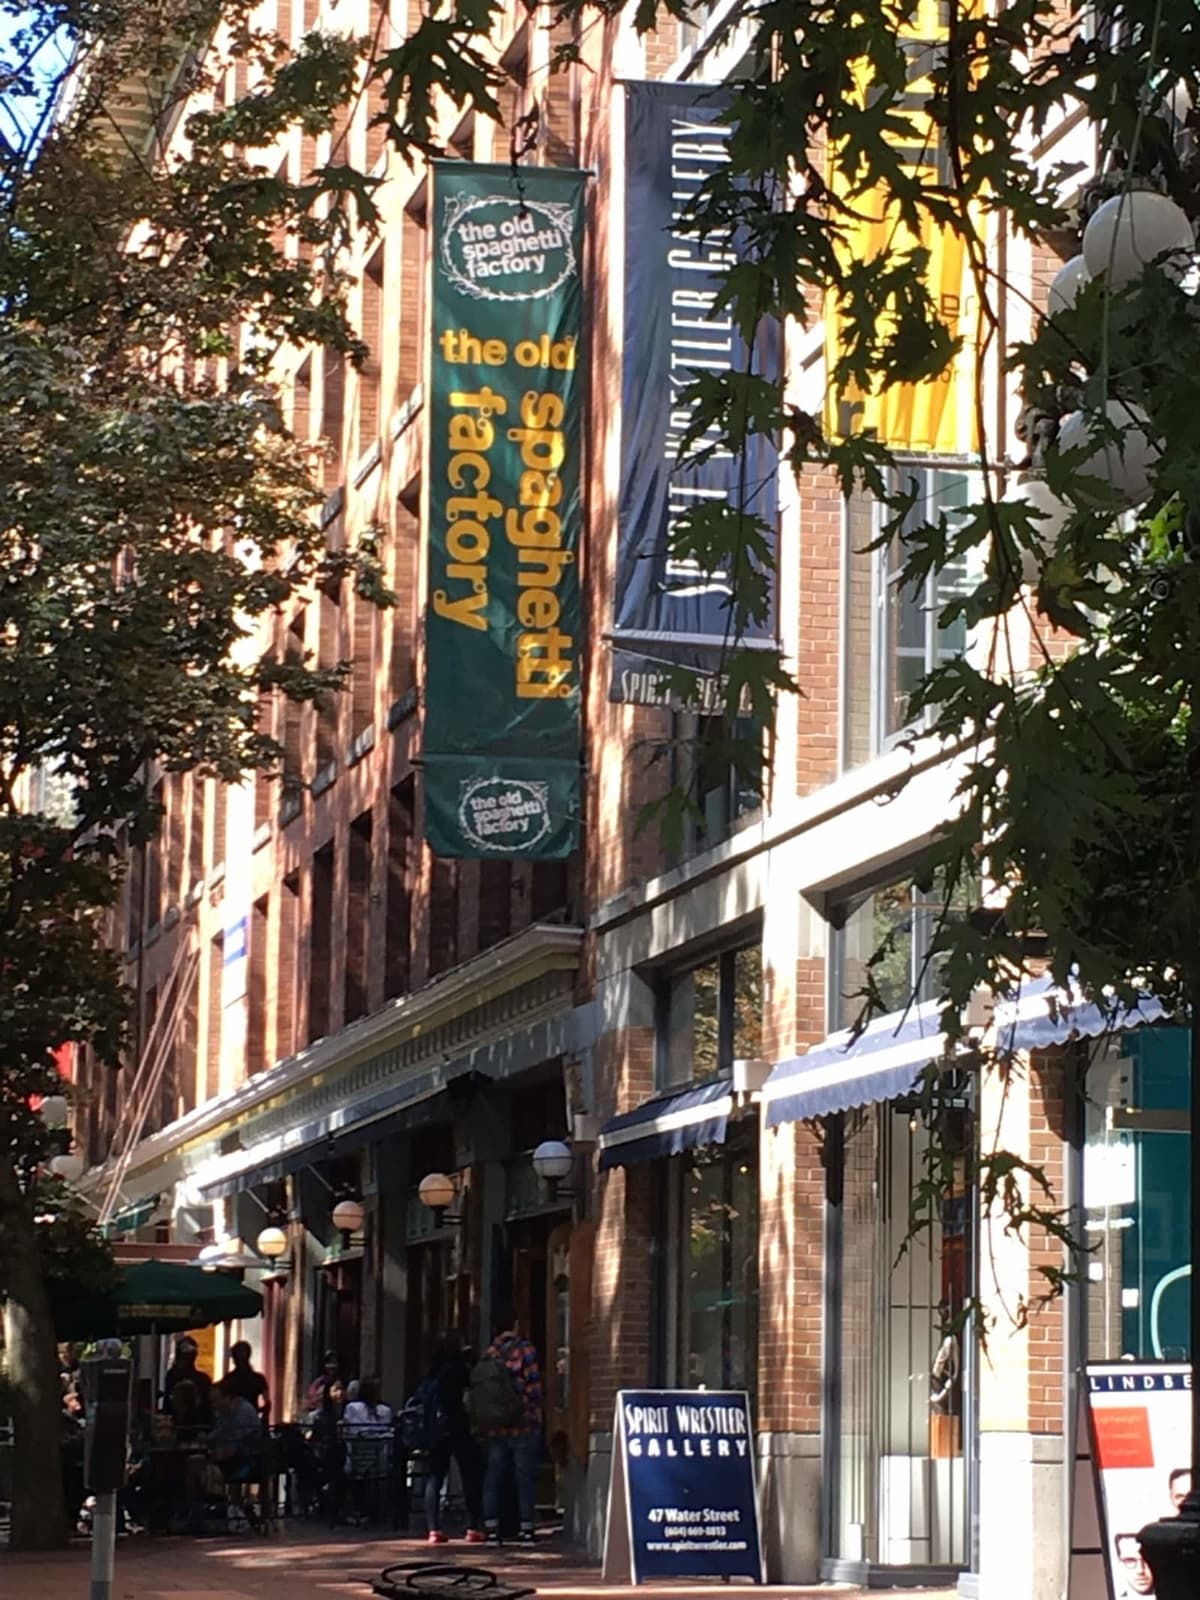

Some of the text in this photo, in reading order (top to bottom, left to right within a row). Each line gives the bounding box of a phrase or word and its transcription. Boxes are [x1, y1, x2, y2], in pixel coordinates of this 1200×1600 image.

[458, 213, 535, 242] the old
[462, 229, 563, 260] spaghetti
[466, 254, 546, 279] factory
[440, 328, 577, 370] the old
[433, 386, 507, 632] factory
[506, 390, 574, 698] spaghetti
[470, 790, 522, 811] the old
[473, 801, 542, 823] spaghetti
[475, 817, 530, 836] factory
[625, 1404, 746, 1435] SPIRIT WRESTLER
[628, 1438, 747, 1457] GALLERY
[648, 1508, 741, 1522] 47 Water Street
